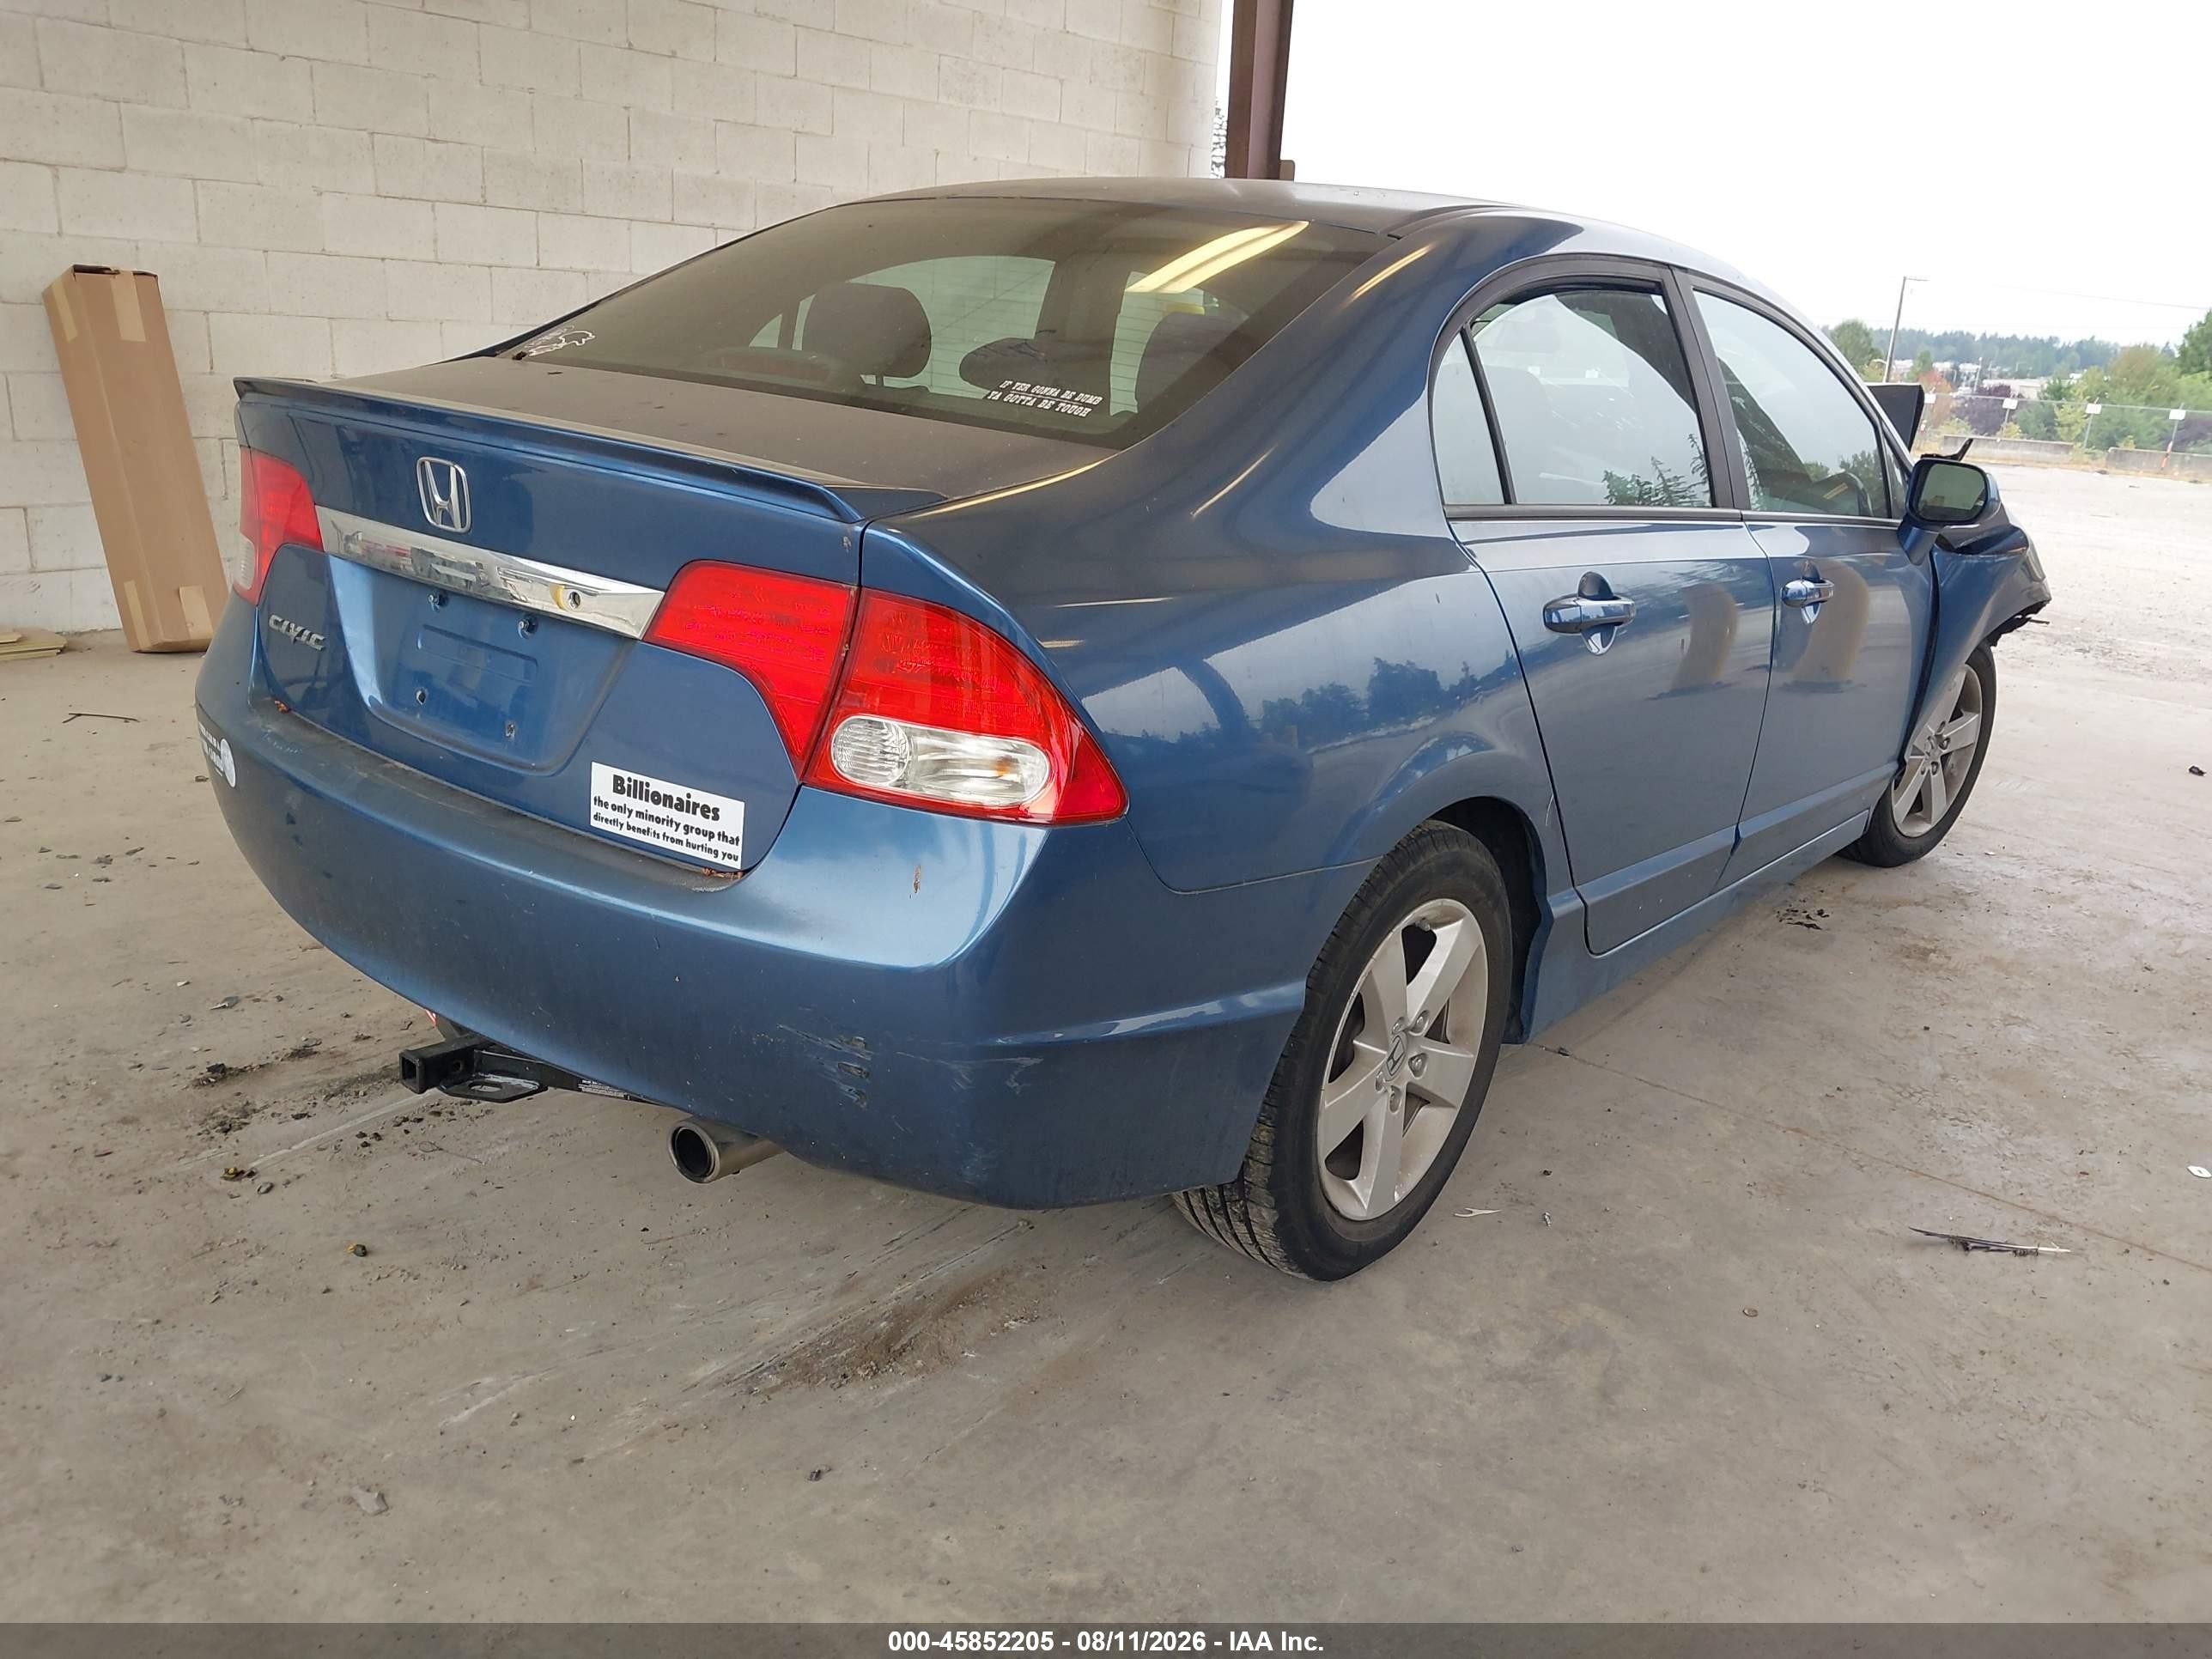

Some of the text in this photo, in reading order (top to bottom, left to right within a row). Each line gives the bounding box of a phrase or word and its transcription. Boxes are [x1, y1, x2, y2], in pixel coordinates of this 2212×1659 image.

[987, 391, 1092, 417] YA GOTTA BE TOUGH
[1030, 385, 1061, 397] GONNA
[1060, 391, 1076, 399] BE
[1077, 392, 1103, 405] DUMB
[269, 614, 325, 651] CIVIC
[612, 774, 720, 821] Billionaires
[592, 812, 738, 862] directly benefits from hurting you
[593, 796, 740, 847] the only minority group that
